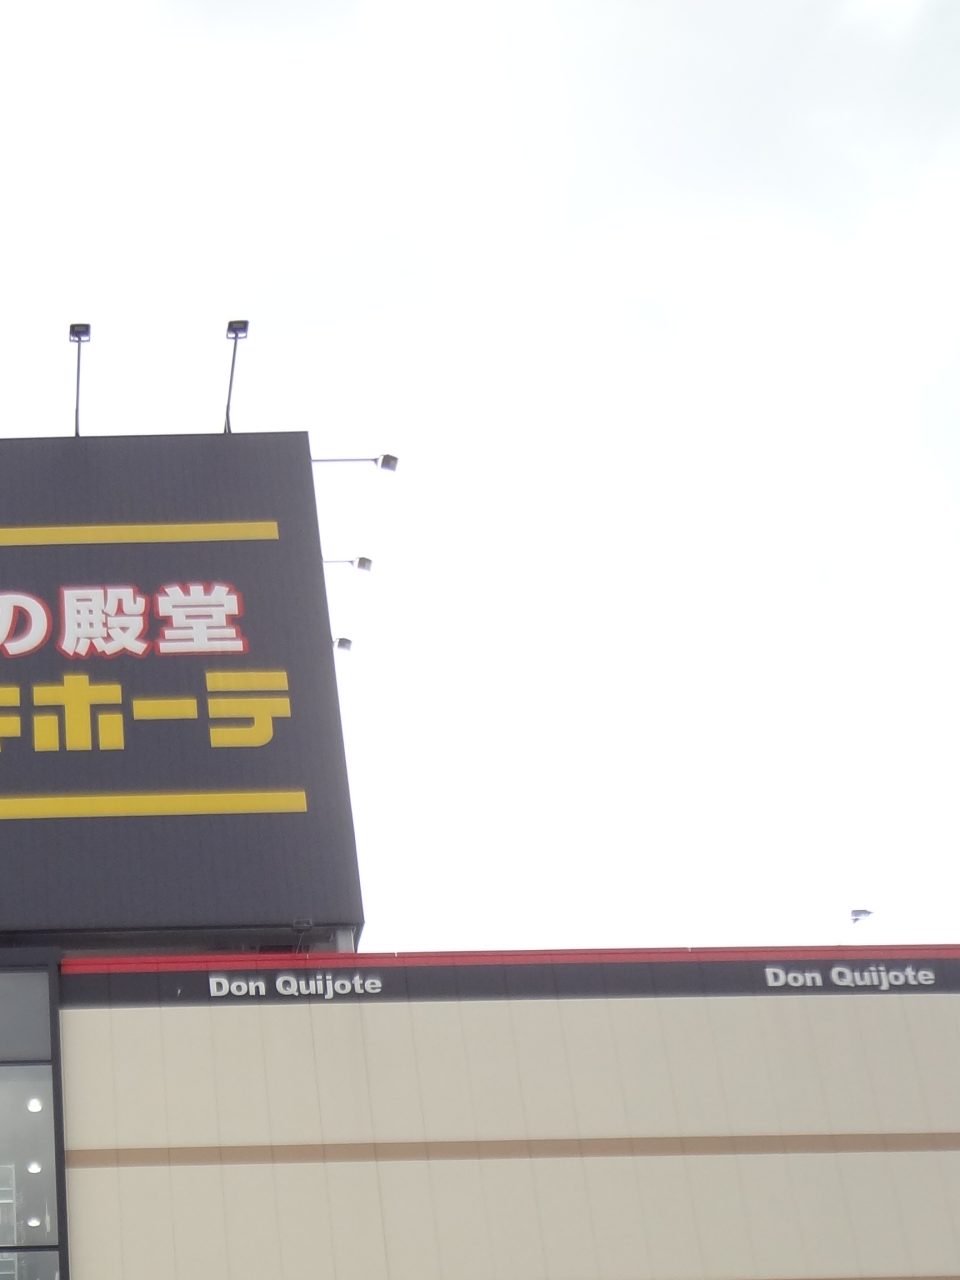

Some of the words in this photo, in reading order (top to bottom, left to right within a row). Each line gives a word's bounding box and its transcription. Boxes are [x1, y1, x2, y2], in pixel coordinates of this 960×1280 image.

[208, 976, 266, 997] Don
[275, 974, 383, 999] Quijote
[765, 967, 823, 987] Don
[831, 966, 936, 990] Quijote
